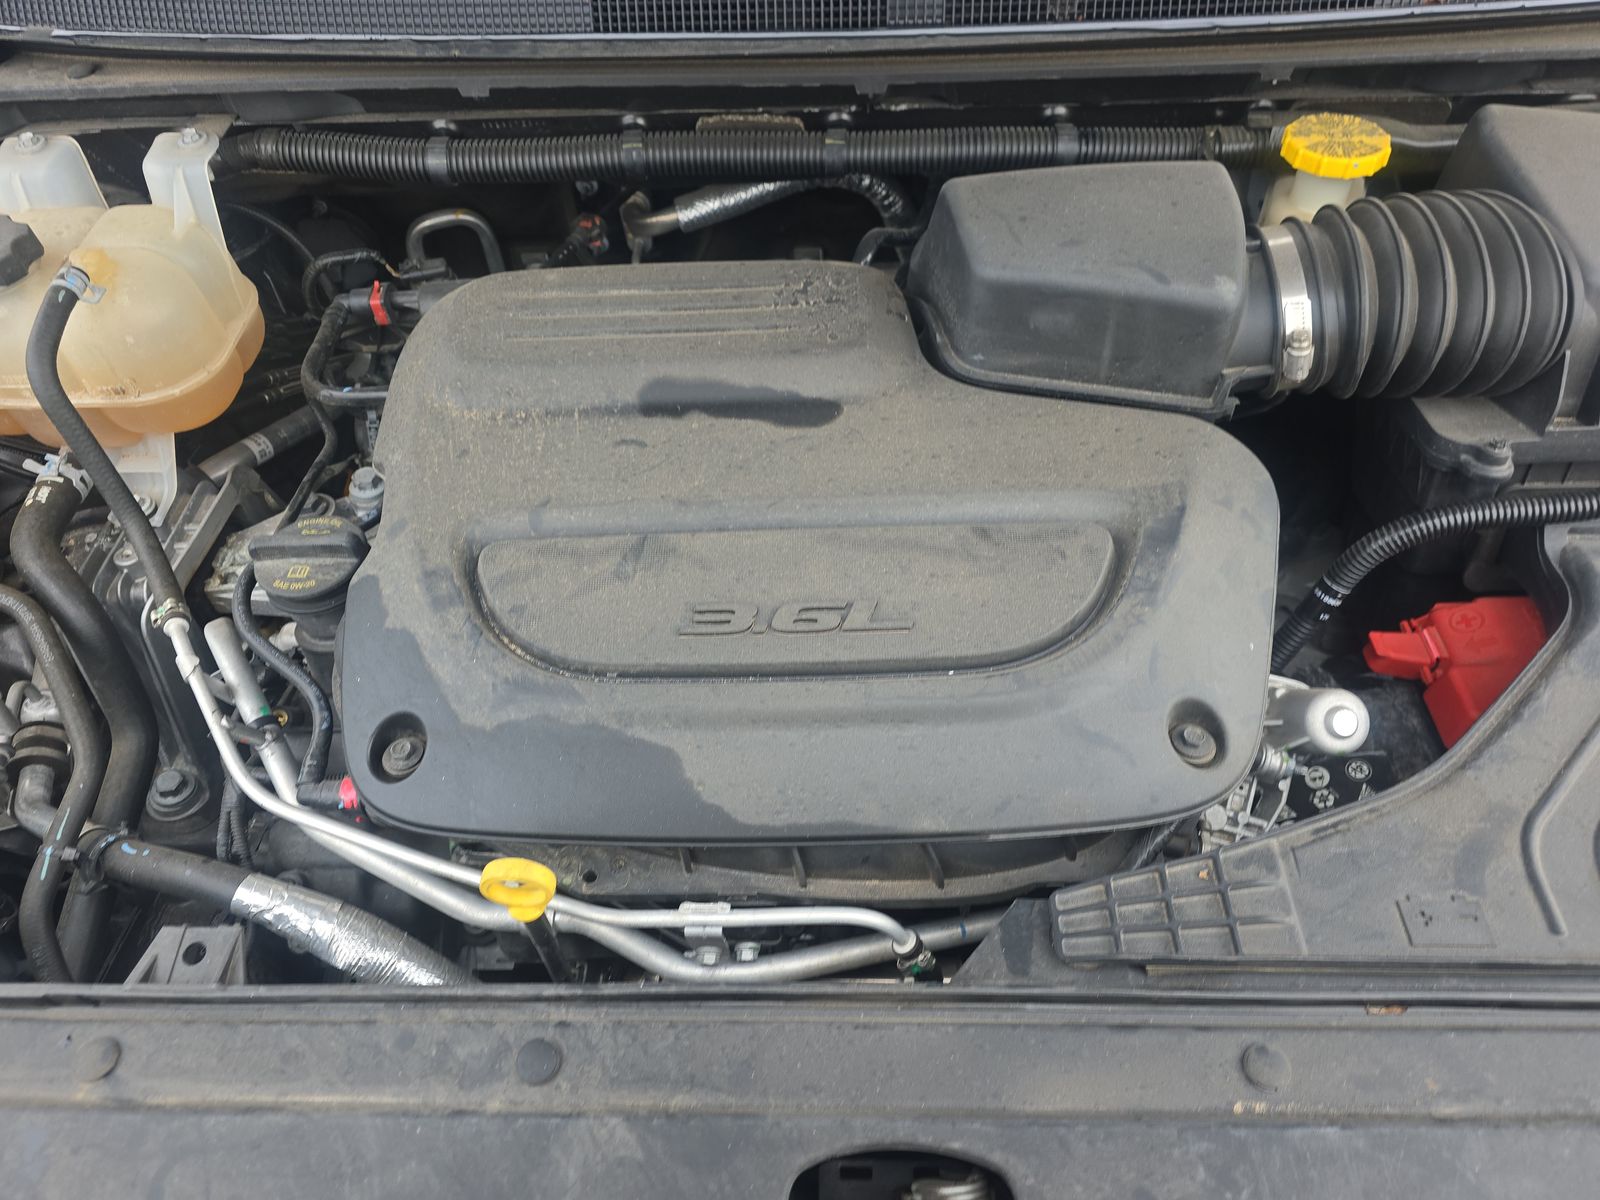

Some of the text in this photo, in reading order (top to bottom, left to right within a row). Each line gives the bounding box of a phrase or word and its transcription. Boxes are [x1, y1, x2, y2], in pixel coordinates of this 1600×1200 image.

[297, 517, 330, 529] ENGINE
[272, 579, 289, 591] SAE
[678, 601, 915, 637] 3.6L
